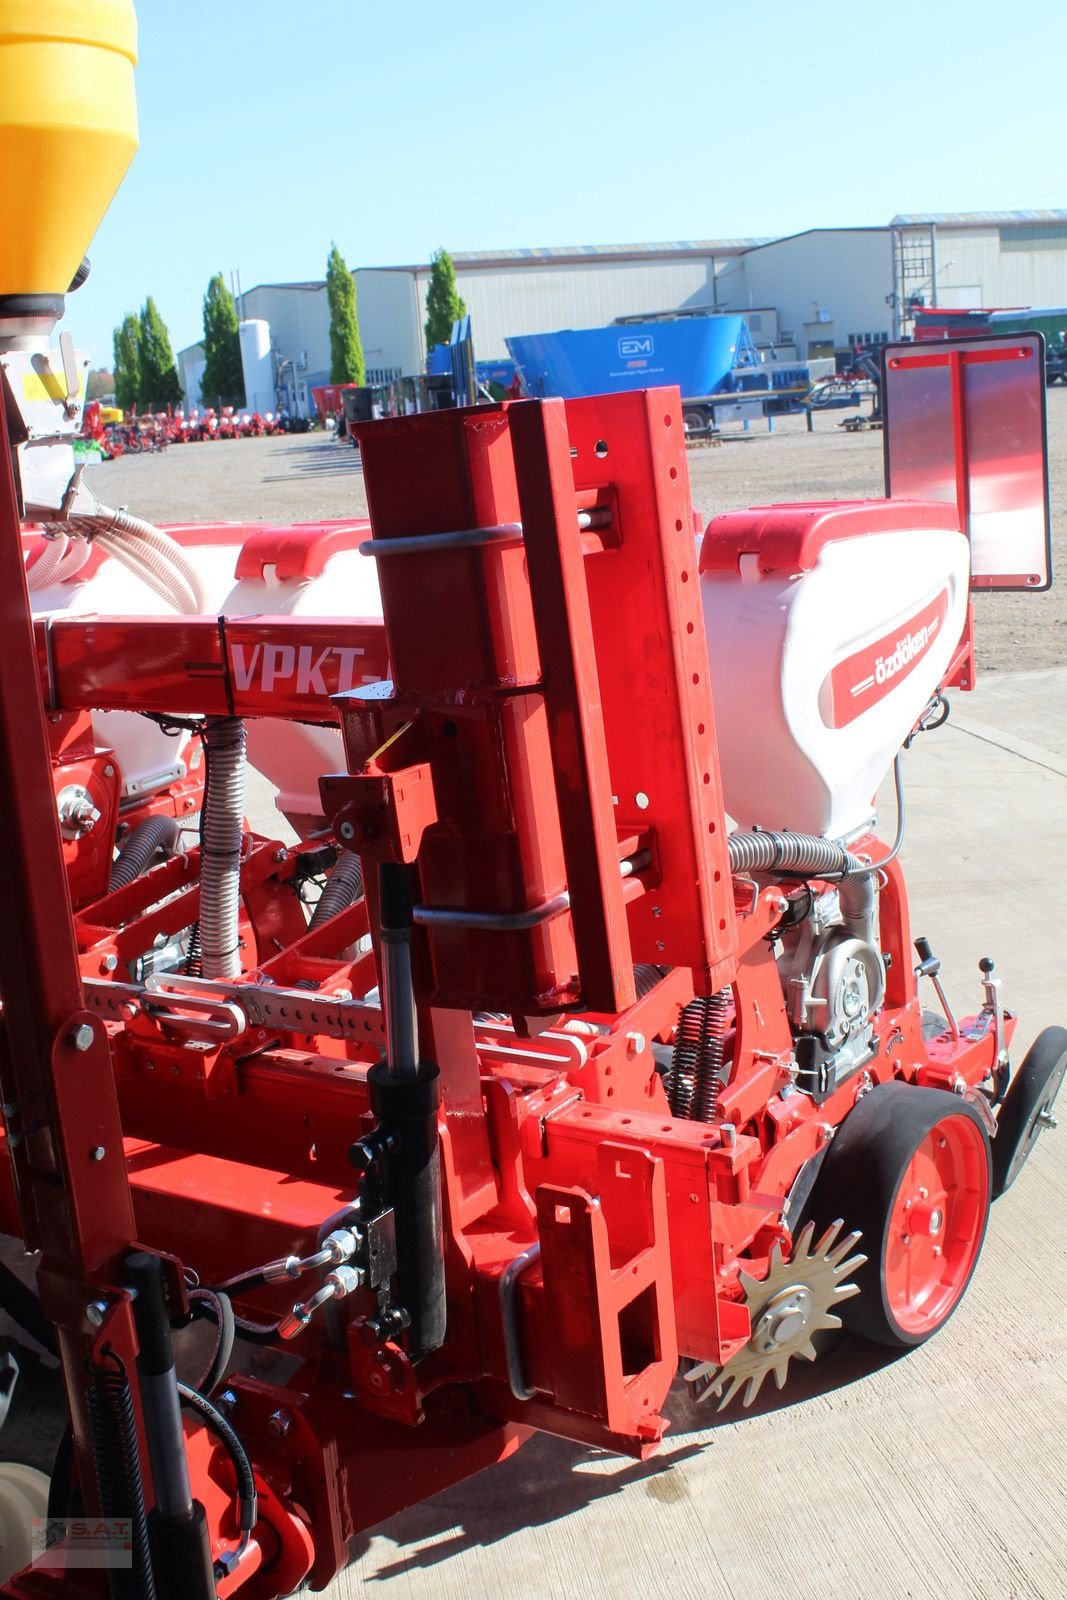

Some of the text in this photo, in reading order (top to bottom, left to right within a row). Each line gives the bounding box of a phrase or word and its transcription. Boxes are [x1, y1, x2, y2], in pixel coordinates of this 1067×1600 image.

[621, 339, 651, 354] EM
[231, 643, 393, 695] VPKT-
[875, 626, 929, 684] özdöken
[191, 1393, 216, 1416] MSHA
